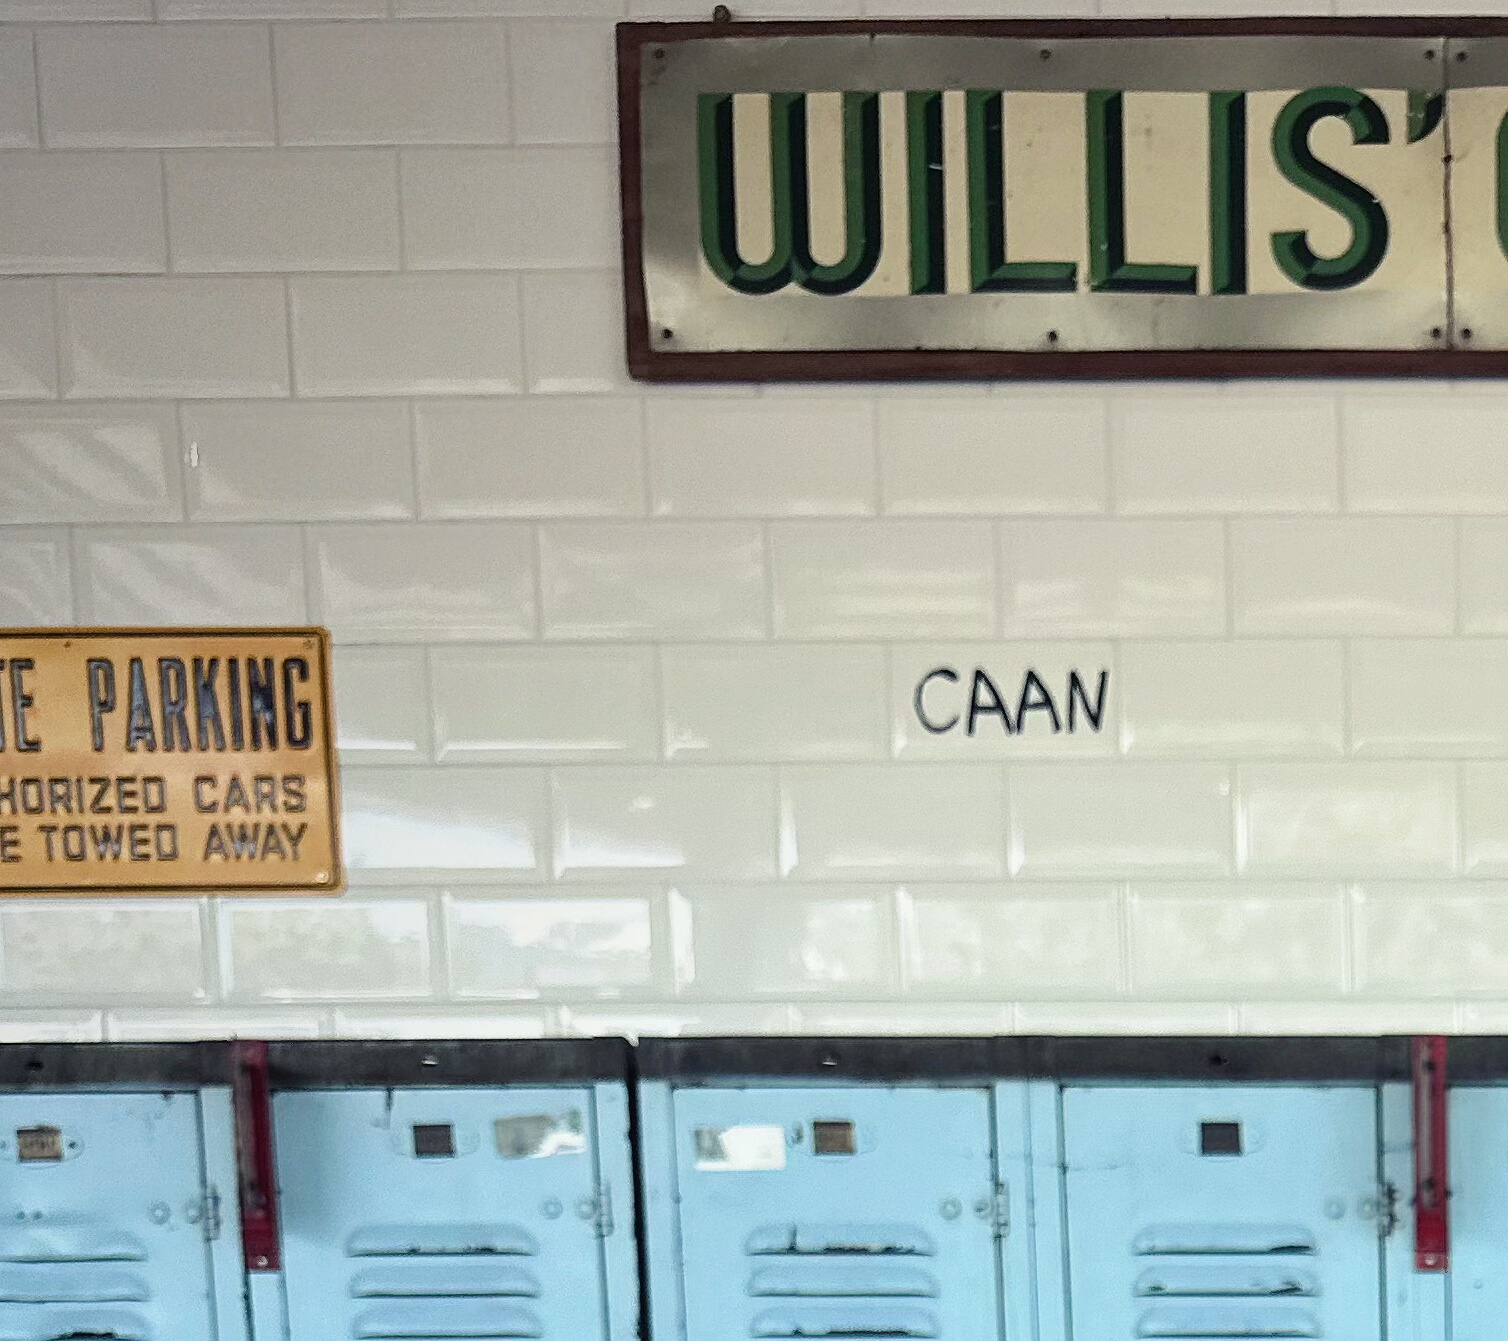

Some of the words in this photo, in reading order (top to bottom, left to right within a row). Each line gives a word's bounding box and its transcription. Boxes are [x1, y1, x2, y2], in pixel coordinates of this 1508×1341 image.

[698, 84, 1444, 296] WILLIS'
[0, 656, 42, 752] E
[86, 656, 313, 752] PARKING
[914, 668, 1110, 736] CAAN
[193, 774, 308, 815] CARS
[38, 823, 180, 863] TOWED
[203, 822, 308, 863] AWAY
